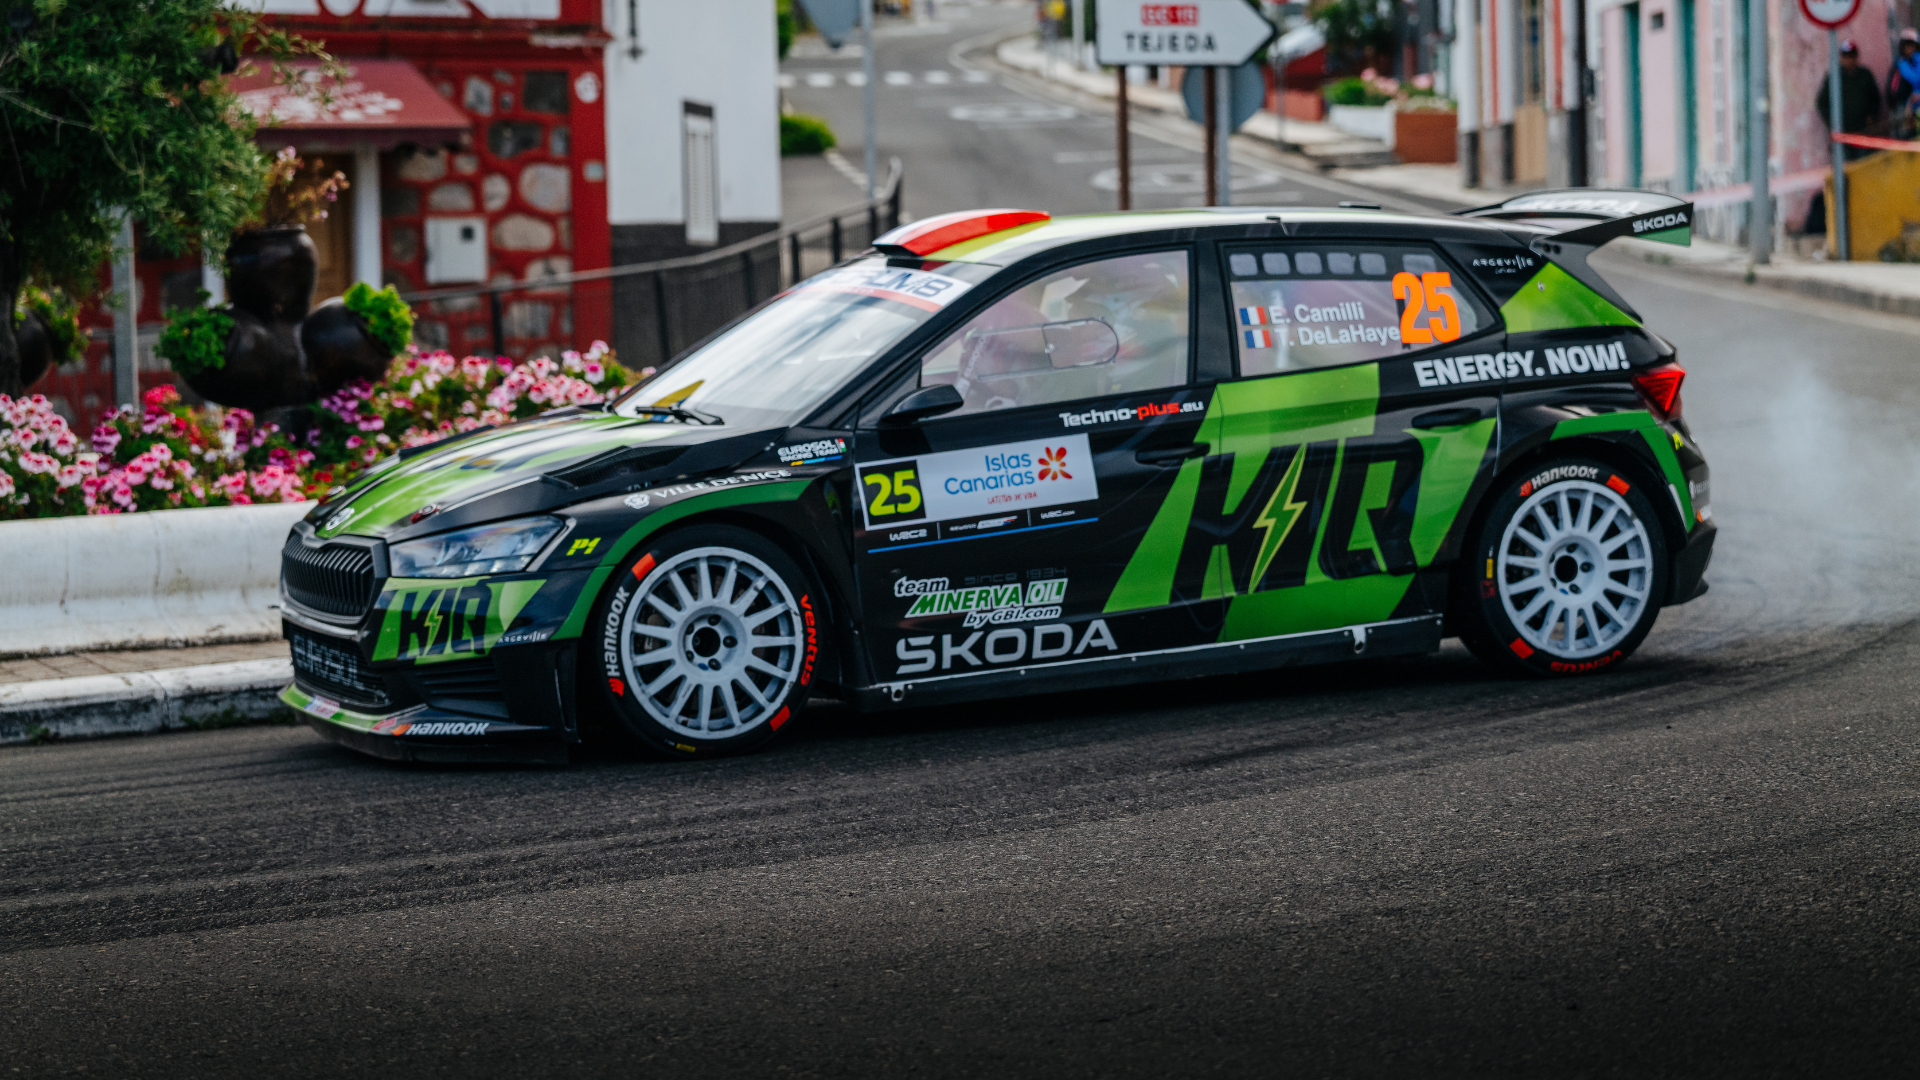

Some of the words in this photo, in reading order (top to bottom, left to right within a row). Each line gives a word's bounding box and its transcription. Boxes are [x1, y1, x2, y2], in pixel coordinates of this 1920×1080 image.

[1124, 32, 1217, 52] TEJEDA
[1632, 211, 1688, 233] SKODA
[1268, 305, 1291, 325] E.
[1294, 301, 1365, 323] Camilli
[1392, 271, 1461, 344] 25
[1273, 328, 1294, 347] T.
[1297, 323, 1401, 346] DeLaHaye
[1413, 350, 1545, 388] ENERGY.
[1545, 341, 1631, 375] NOW!
[1059, 401, 1204, 427] Techno-plus.eu
[778, 440, 836, 457] EUROSOL
[985, 453, 1032, 473] Islas
[654, 481, 709, 498] VILLE
[710, 476, 740, 486] DE
[740, 469, 791, 482] NICE
[863, 469, 922, 516] 25
[944, 470, 1035, 495] Canarias
[566, 537, 601, 556] P1
[894, 576, 949, 597] team
[904, 583, 1023, 618] MINERVA
[1026, 579, 1067, 605] OIL
[896, 619, 1118, 675] SKODA
